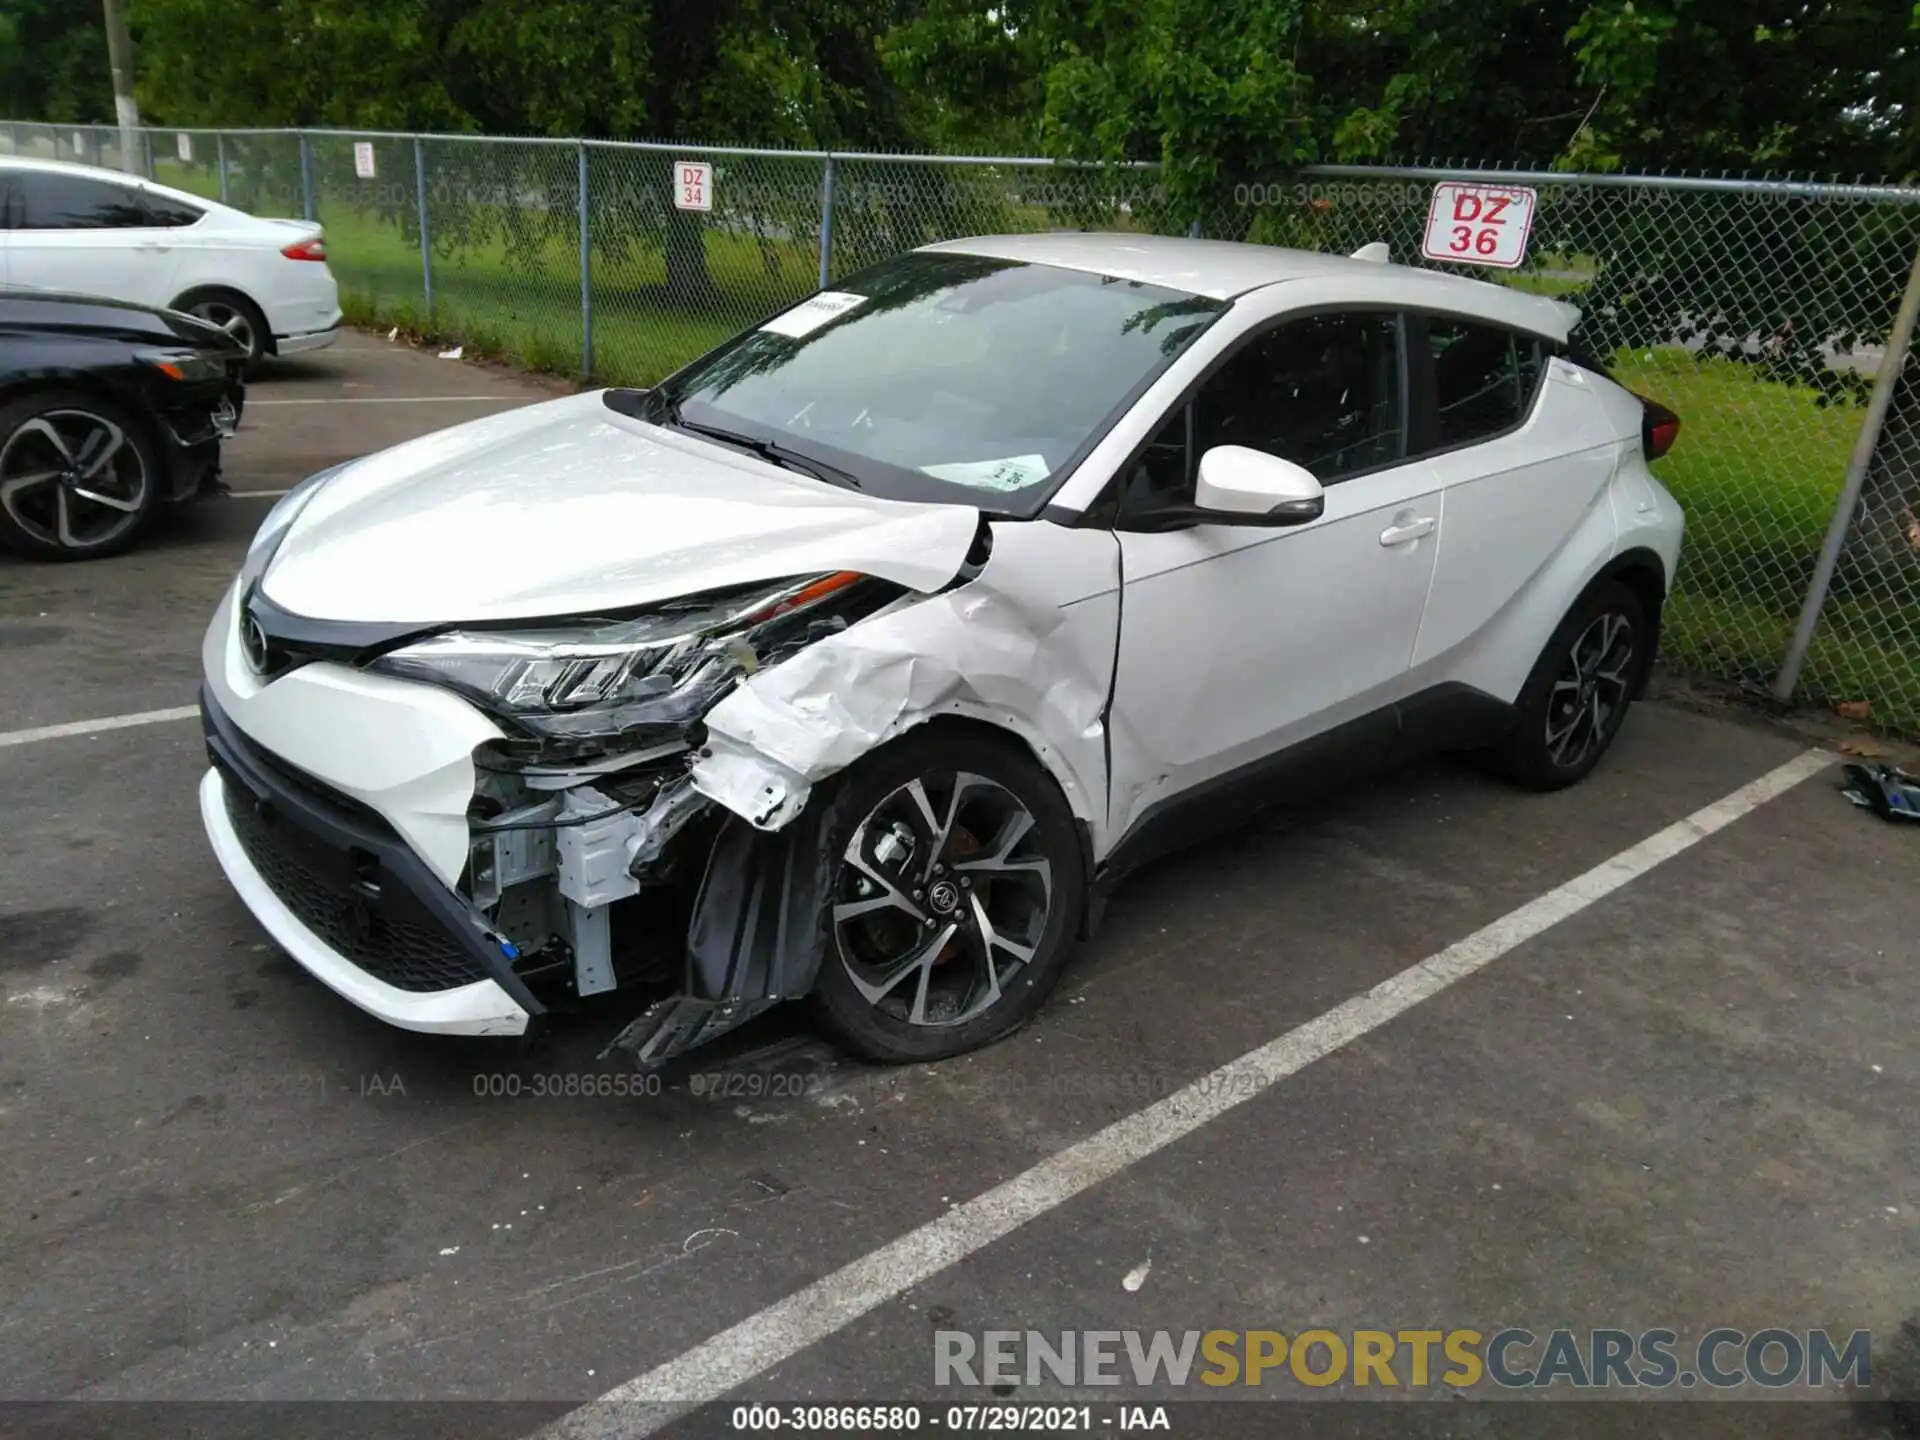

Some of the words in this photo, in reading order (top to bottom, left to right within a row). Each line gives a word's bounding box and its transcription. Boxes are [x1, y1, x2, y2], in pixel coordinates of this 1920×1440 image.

[683, 168, 703, 186] DZ
[684, 187, 702, 204] 34
[1453, 194, 1511, 225] DZ
[1448, 226, 1499, 255] 36
